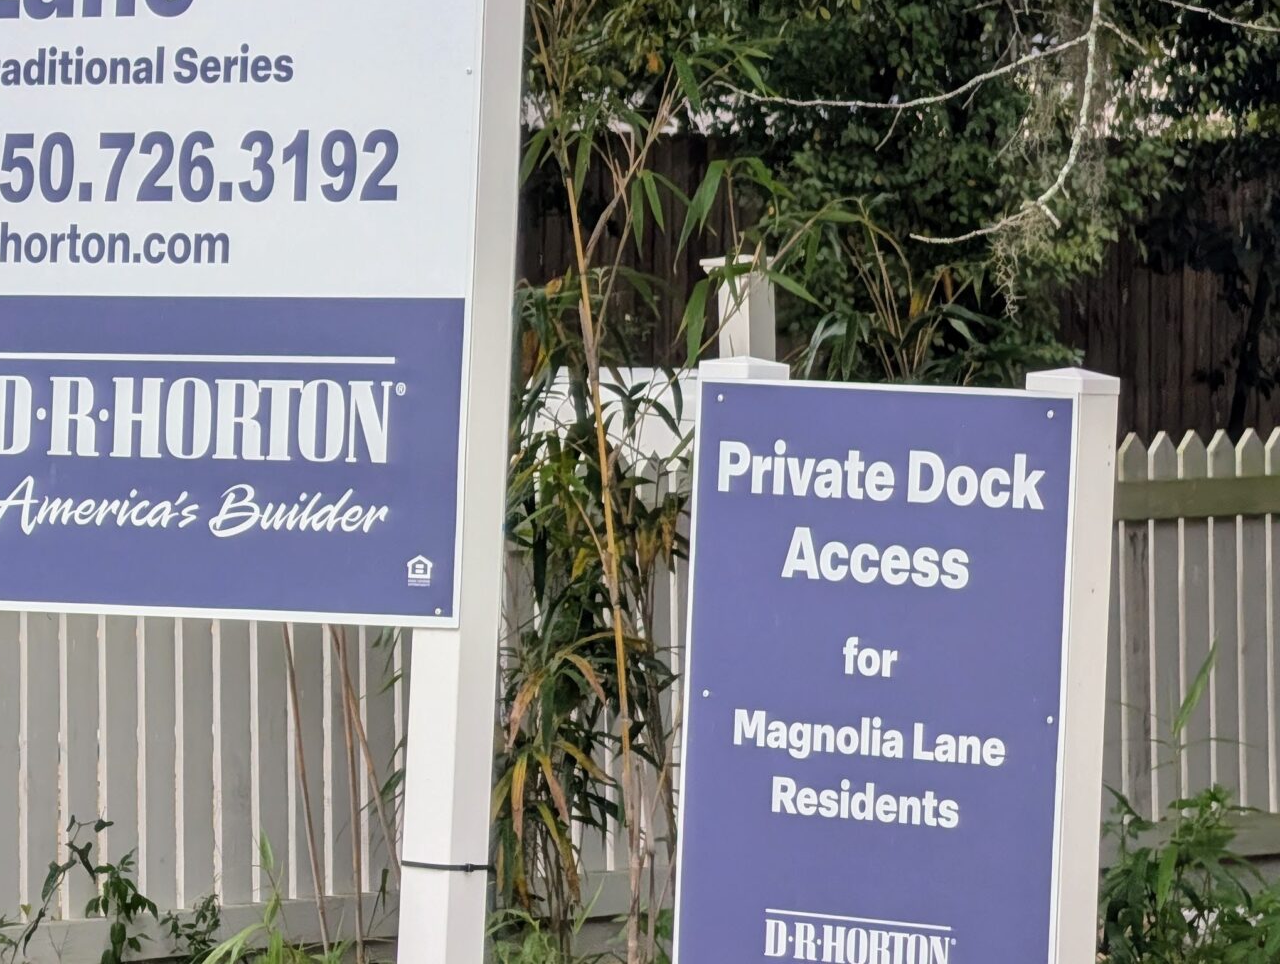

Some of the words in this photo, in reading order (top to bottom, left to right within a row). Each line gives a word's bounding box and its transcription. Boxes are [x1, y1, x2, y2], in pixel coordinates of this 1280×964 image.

[173, 44, 294, 84] Series
[717, 439, 895, 502] Private
[906, 451, 1045, 510] Dock
[208, 483, 389, 538] Builder
[781, 526, 969, 589] Access
[842, 636, 898, 677] for
[732, 708, 904, 760] Magnolia
[912, 722, 1006, 766] Lane
[771, 777, 959, 828] Residents
